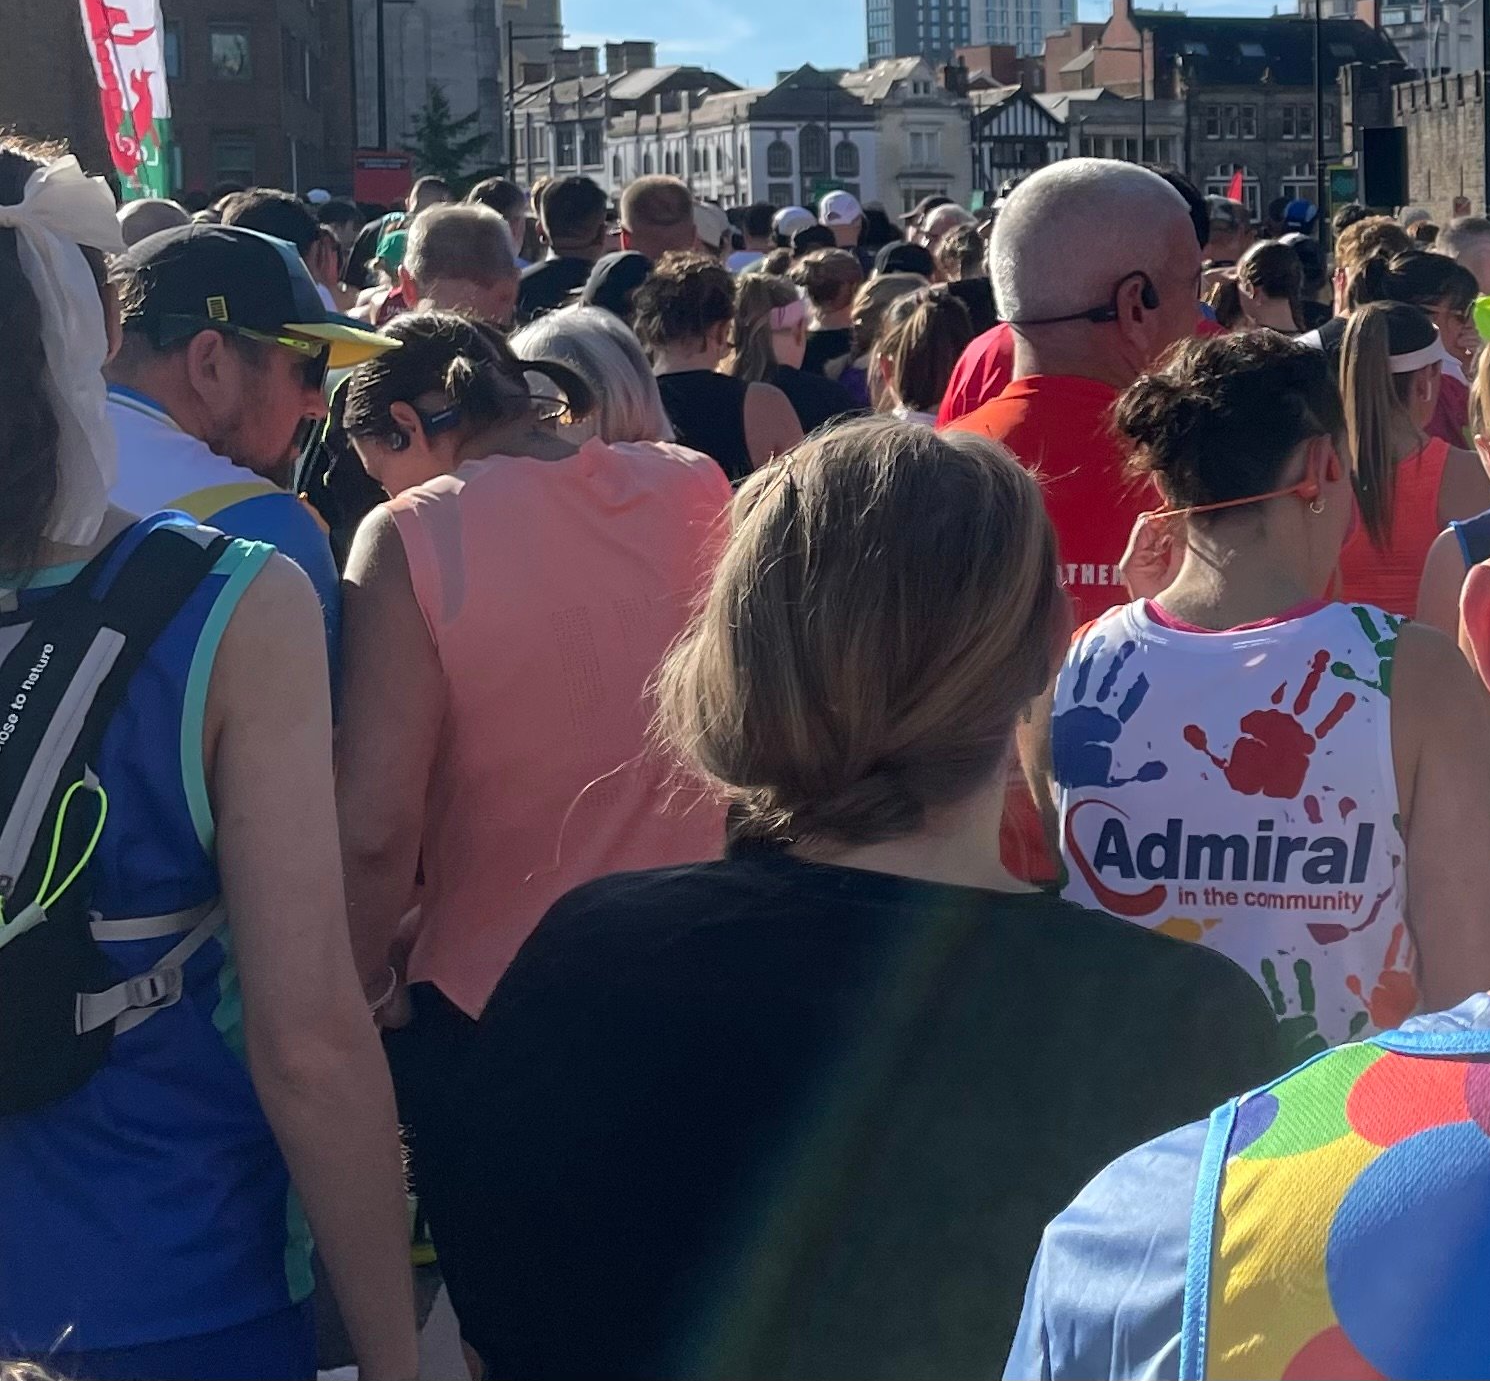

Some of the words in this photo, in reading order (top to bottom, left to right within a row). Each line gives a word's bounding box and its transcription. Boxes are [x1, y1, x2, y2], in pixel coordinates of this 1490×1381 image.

[10, 693, 27, 709] to
[21, 644, 54, 690] nature
[1093, 817, 1375, 885] Admiral
[1178, 887, 1198, 906] in
[1203, 887, 1239, 907] the
[1244, 890, 1364, 915] community
